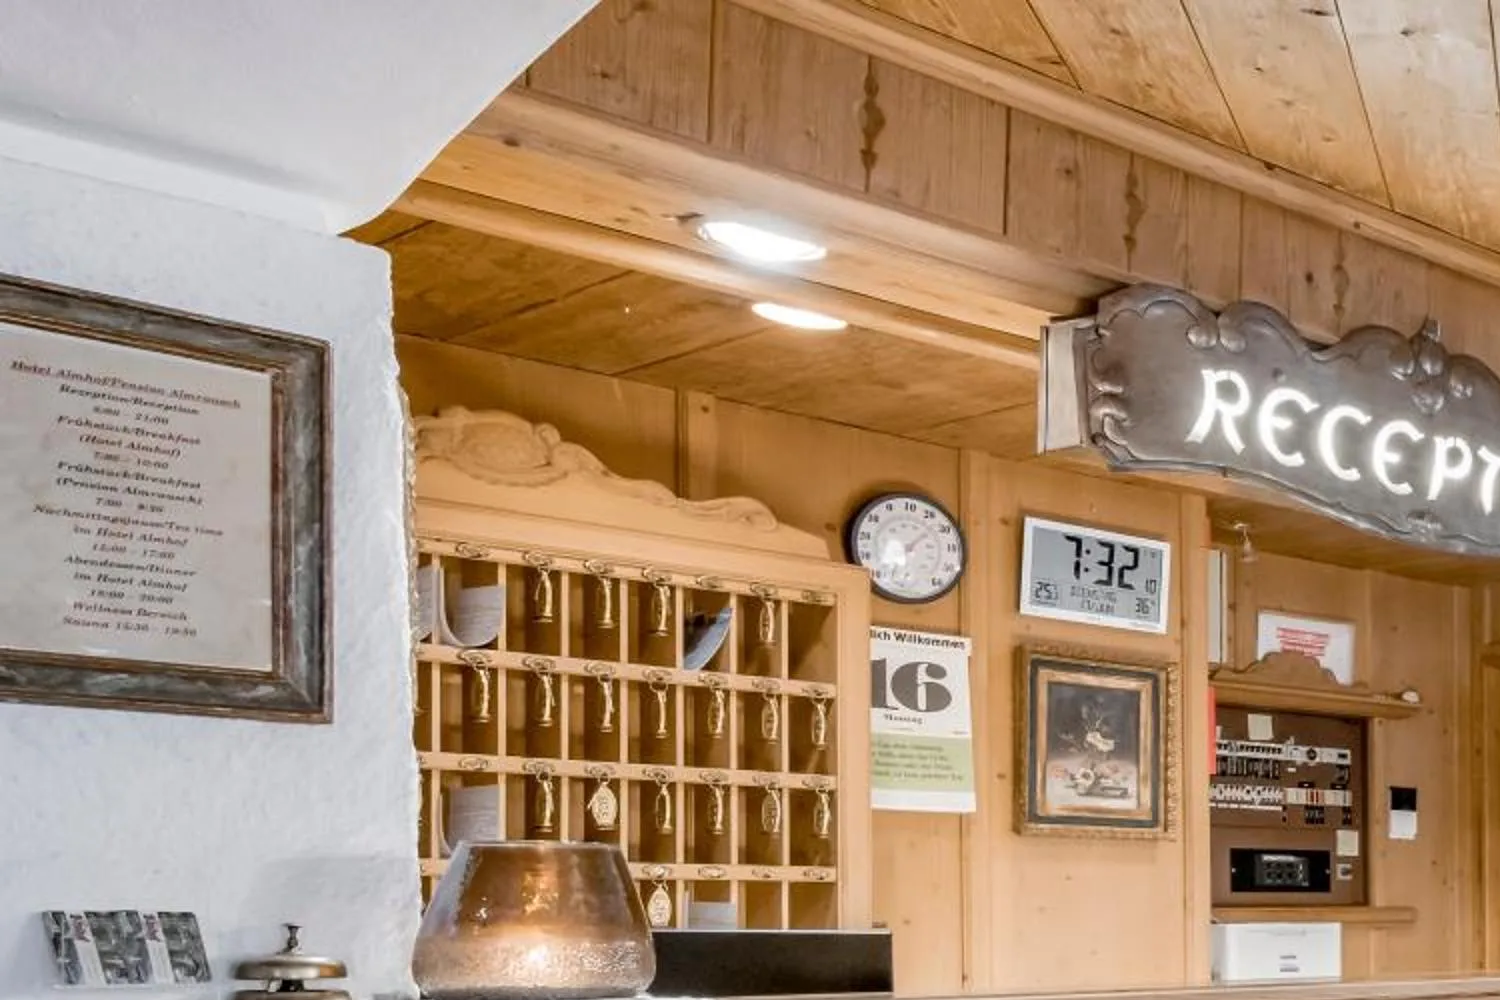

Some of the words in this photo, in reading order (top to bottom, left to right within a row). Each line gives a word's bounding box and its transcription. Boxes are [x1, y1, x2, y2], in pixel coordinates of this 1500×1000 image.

[904, 501, 917, 512] 10
[97, 527, 133, 540] Hotel
[1063, 534, 1139, 591] 7:32
[97, 573, 133, 586] Hotel
[893, 632, 965, 650] Willkommen
[871, 658, 952, 713] 16
